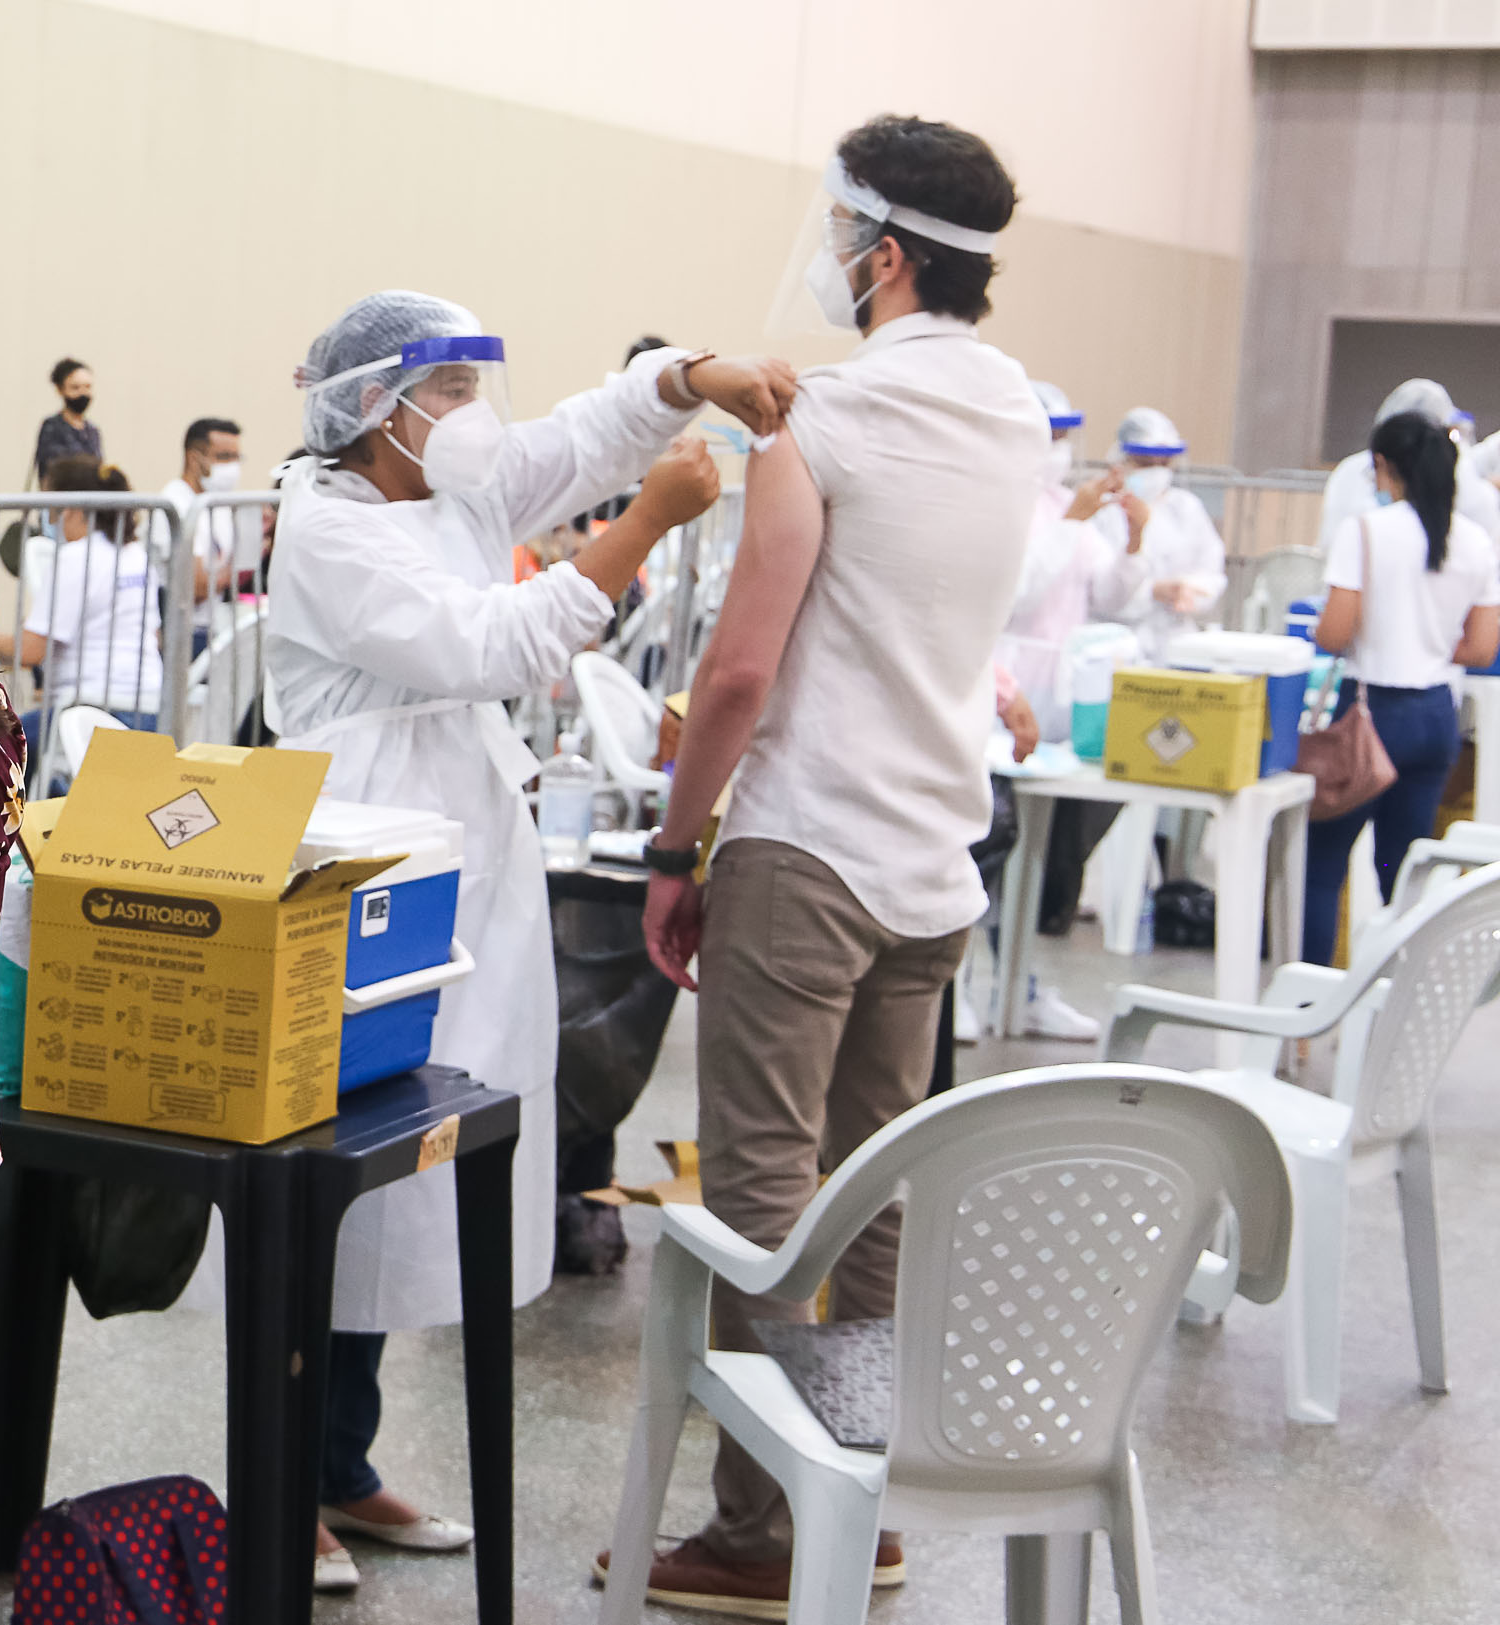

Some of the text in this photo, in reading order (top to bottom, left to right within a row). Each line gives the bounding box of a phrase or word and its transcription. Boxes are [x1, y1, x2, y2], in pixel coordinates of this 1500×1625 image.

[180, 774, 216, 785] PERIGO
[60, 852, 265, 884] MANUSEIE PELAS ALÇAS
[113, 901, 211, 928] ASTROBOX
